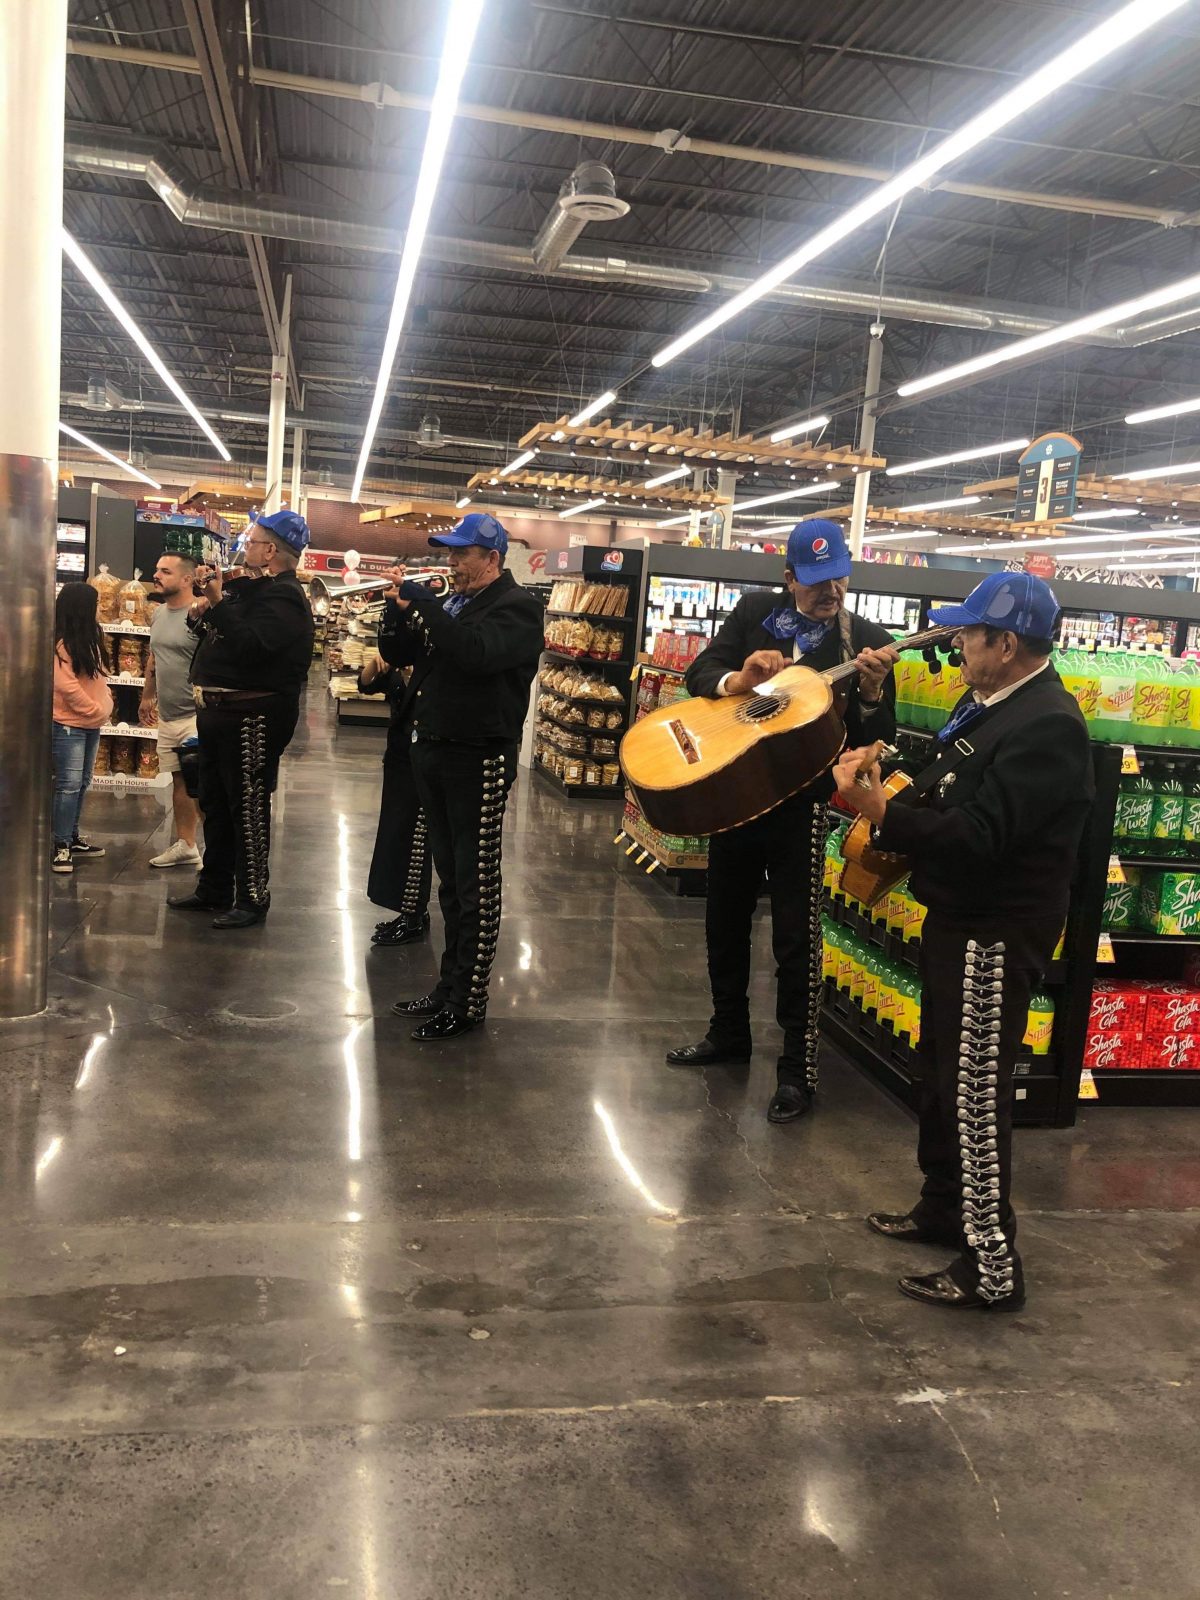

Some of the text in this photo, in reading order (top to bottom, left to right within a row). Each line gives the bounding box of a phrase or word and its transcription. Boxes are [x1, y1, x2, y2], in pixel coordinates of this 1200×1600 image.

[1040, 477, 1049, 504] 3
[102, 625, 124, 633] ECHO
[136, 627, 151, 635] CAS
[132, 729, 153, 737] CASA
[94, 777, 115, 785] MADE
[1171, 879, 1200, 910] Sha
[1090, 995, 1126, 1018] Shasta
[1165, 998, 1200, 1019] Shasta
[1099, 1014, 1119, 1029] Cola
[1173, 1015, 1193, 1032] Cola
[1088, 1032, 1123, 1055] Shasta
[1096, 1050, 1117, 1067] Cola
